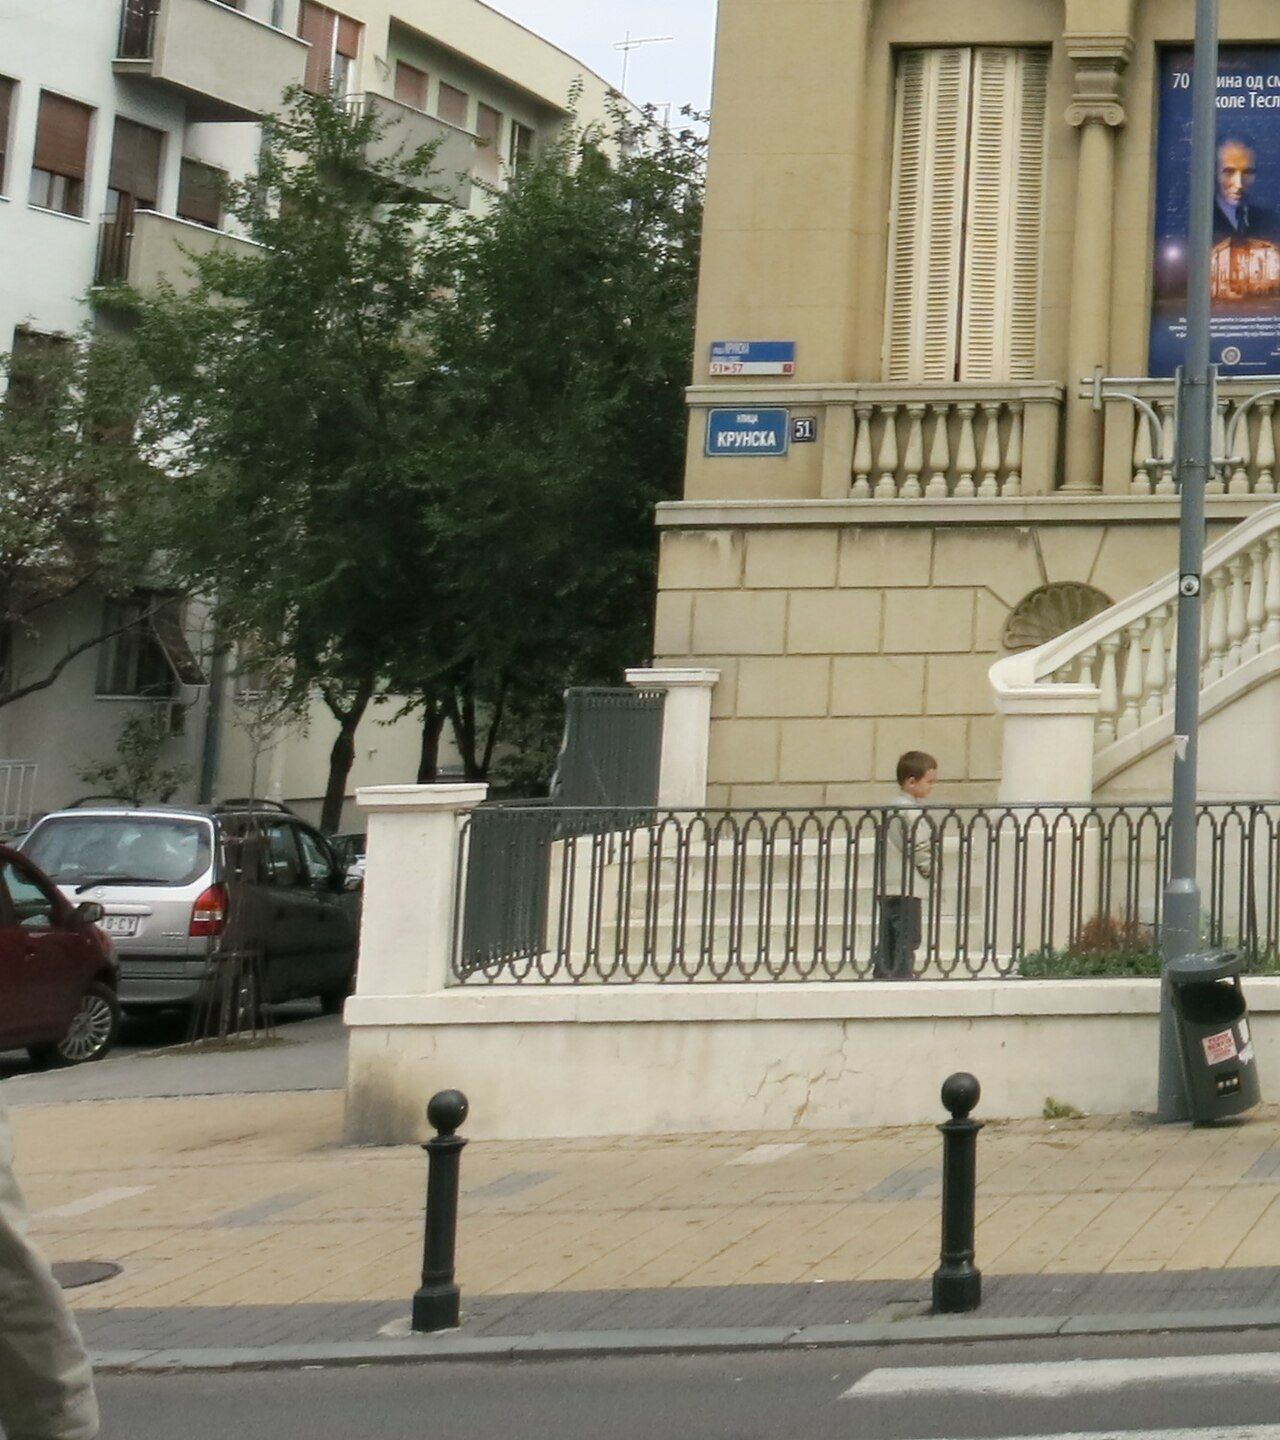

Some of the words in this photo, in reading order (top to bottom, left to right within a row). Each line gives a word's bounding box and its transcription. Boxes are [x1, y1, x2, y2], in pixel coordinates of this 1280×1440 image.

[1172, 73, 1190, 88] 70
[1245, 75, 1263, 90] од
[731, 363, 743, 373] 57
[795, 420, 811, 438] 51
[716, 430, 776, 448] КРУНСКА
